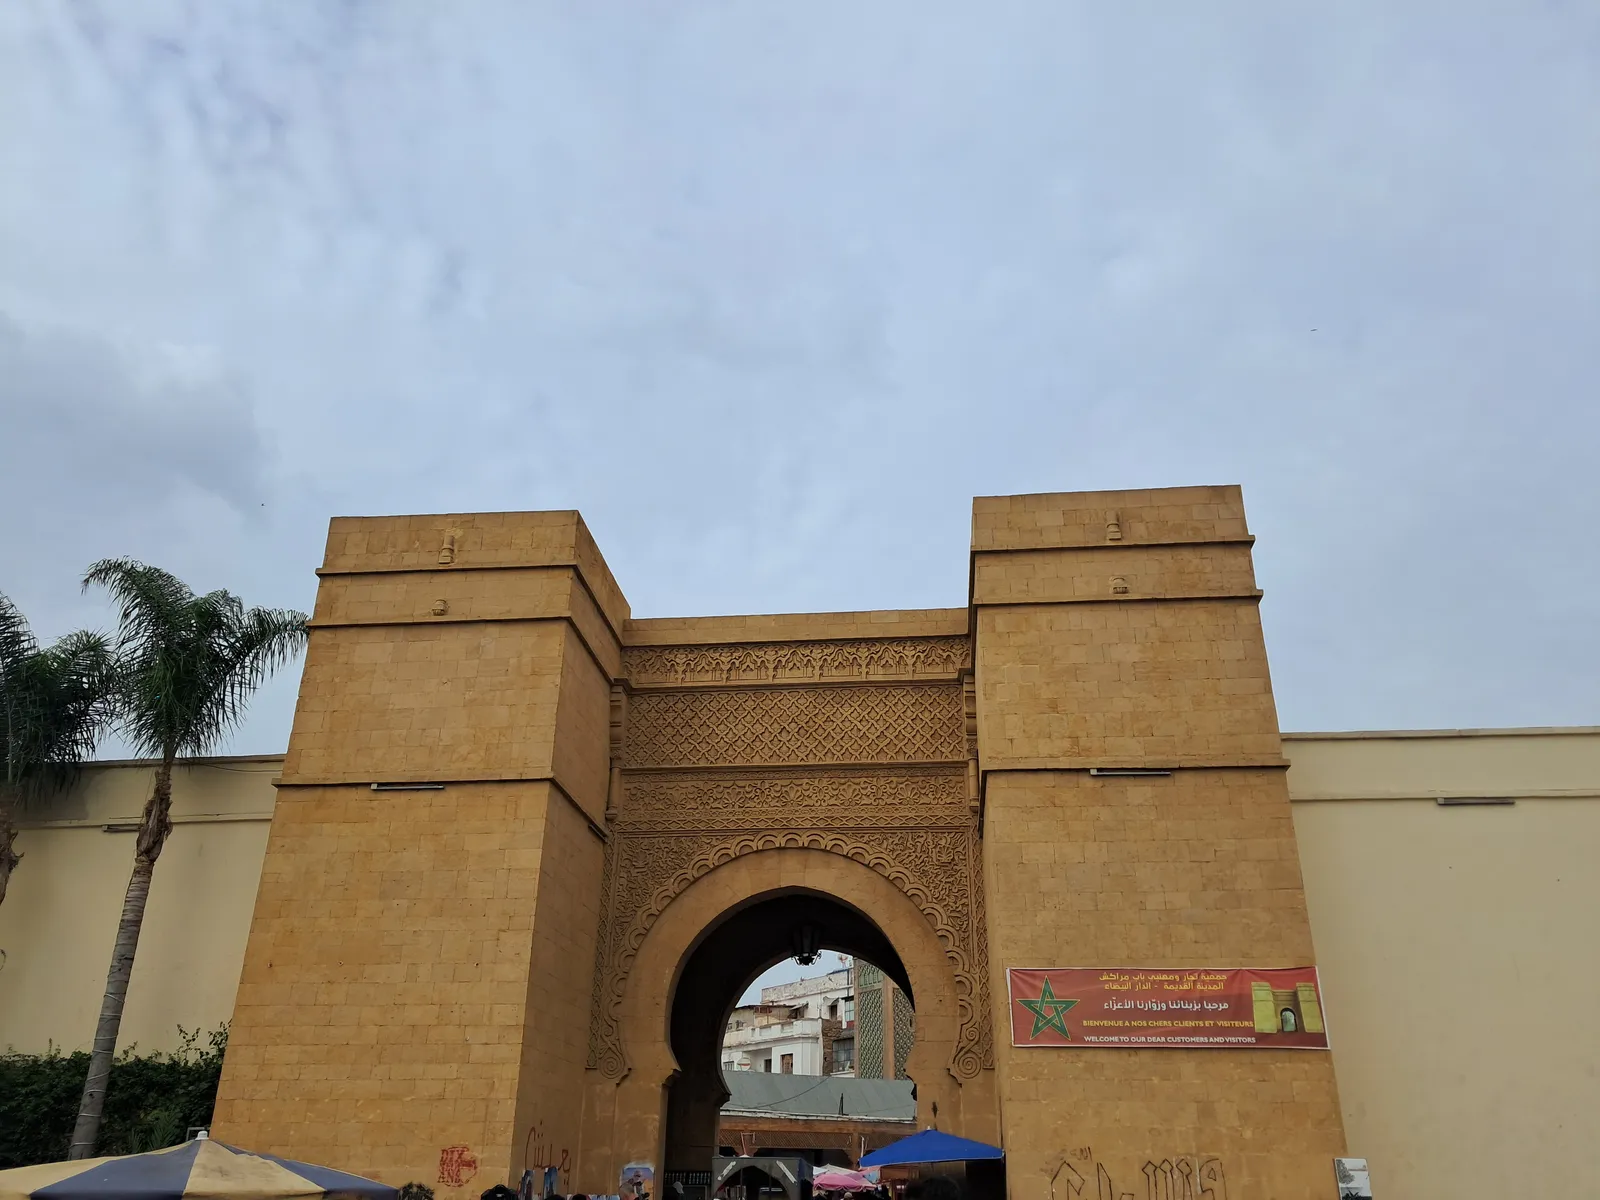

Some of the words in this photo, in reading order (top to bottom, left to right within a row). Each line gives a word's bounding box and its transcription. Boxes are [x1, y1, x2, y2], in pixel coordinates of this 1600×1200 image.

[1099, 972, 1130, 982] مراكش
[1132, 973, 1145, 982] باب
[1183, 972, 1198, 982] تجار
[1201, 972, 1227, 982] جمعية
[1104, 982, 1132, 991] البيضاء
[1134, 982, 1152, 991] الدار
[1163, 982, 1194, 991] القديمة
[1196, 982, 1224, 991] المدينة
[1203, 1000, 1229, 1011] مرحبا
